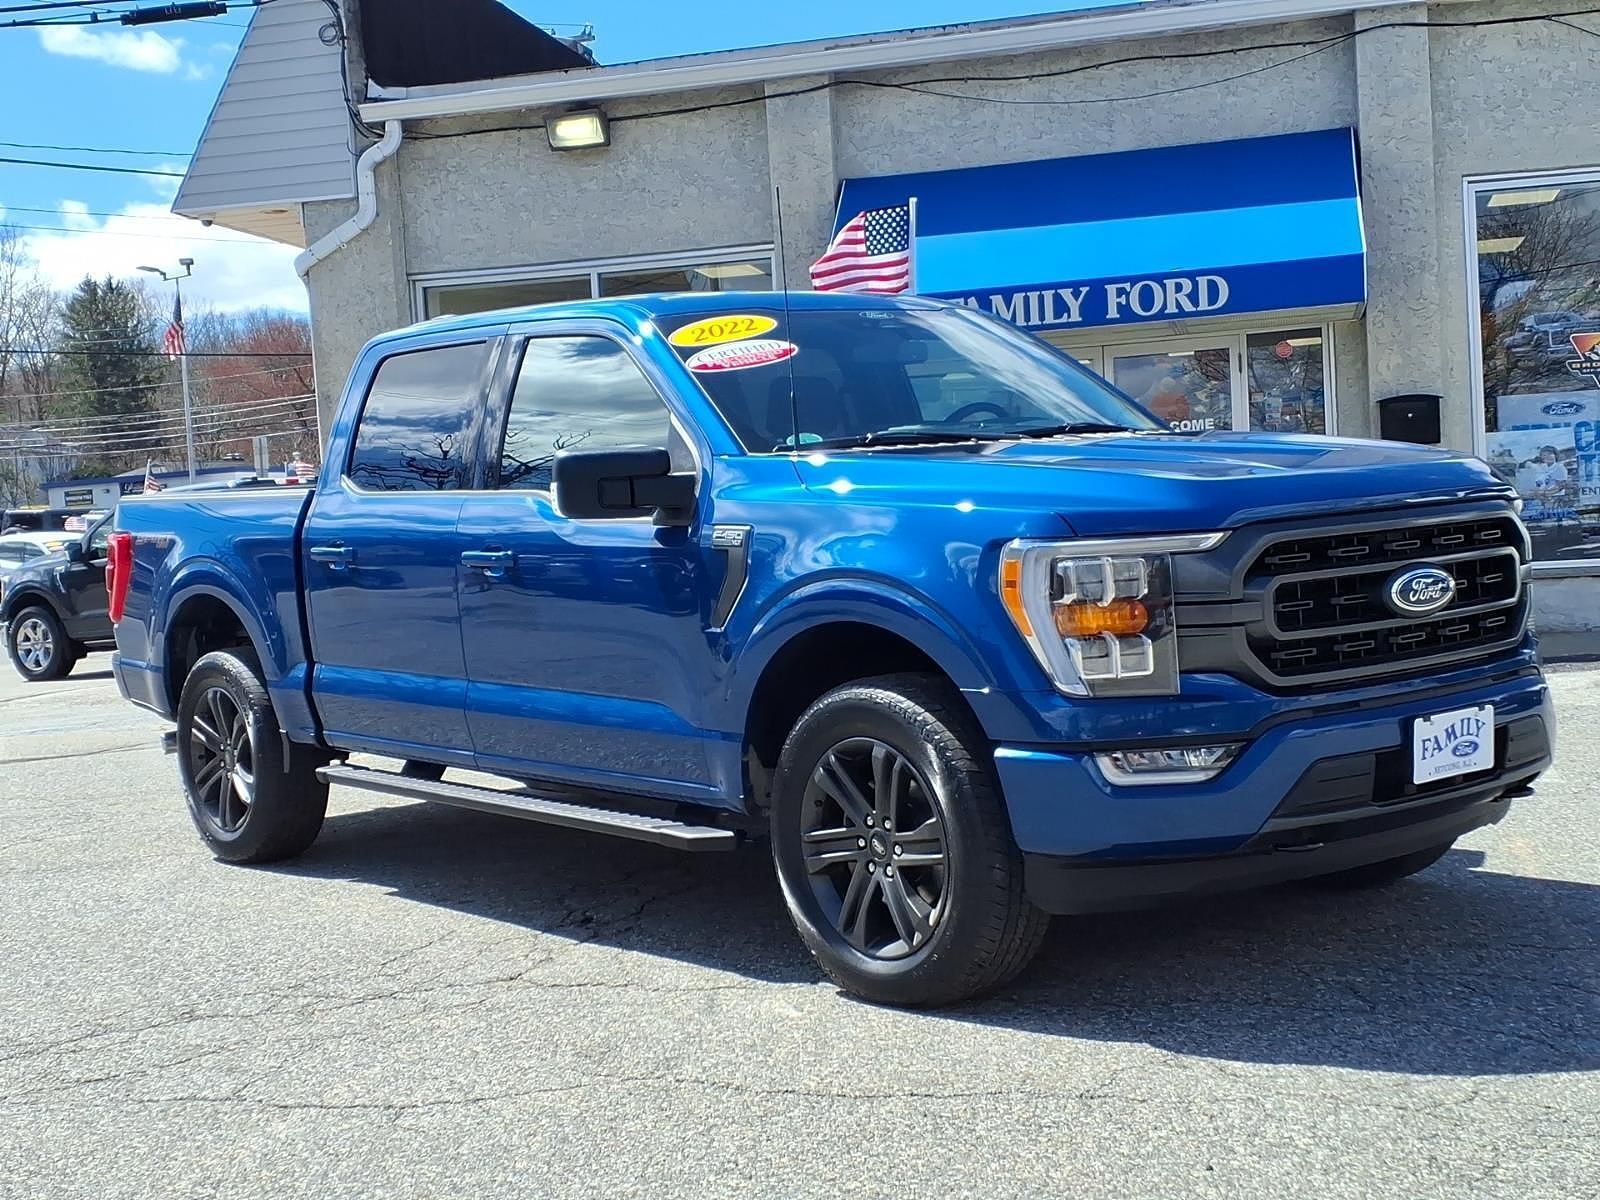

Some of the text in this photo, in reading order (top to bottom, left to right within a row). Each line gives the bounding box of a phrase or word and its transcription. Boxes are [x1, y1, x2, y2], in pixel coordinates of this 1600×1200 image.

[1104, 275, 1230, 319] FORD
[692, 318, 758, 342] 2022
[697, 341, 782, 364] CERTIFIED
[1409, 578, 1448, 602] Ford
[1420, 717, 1486, 761] FAMILY
